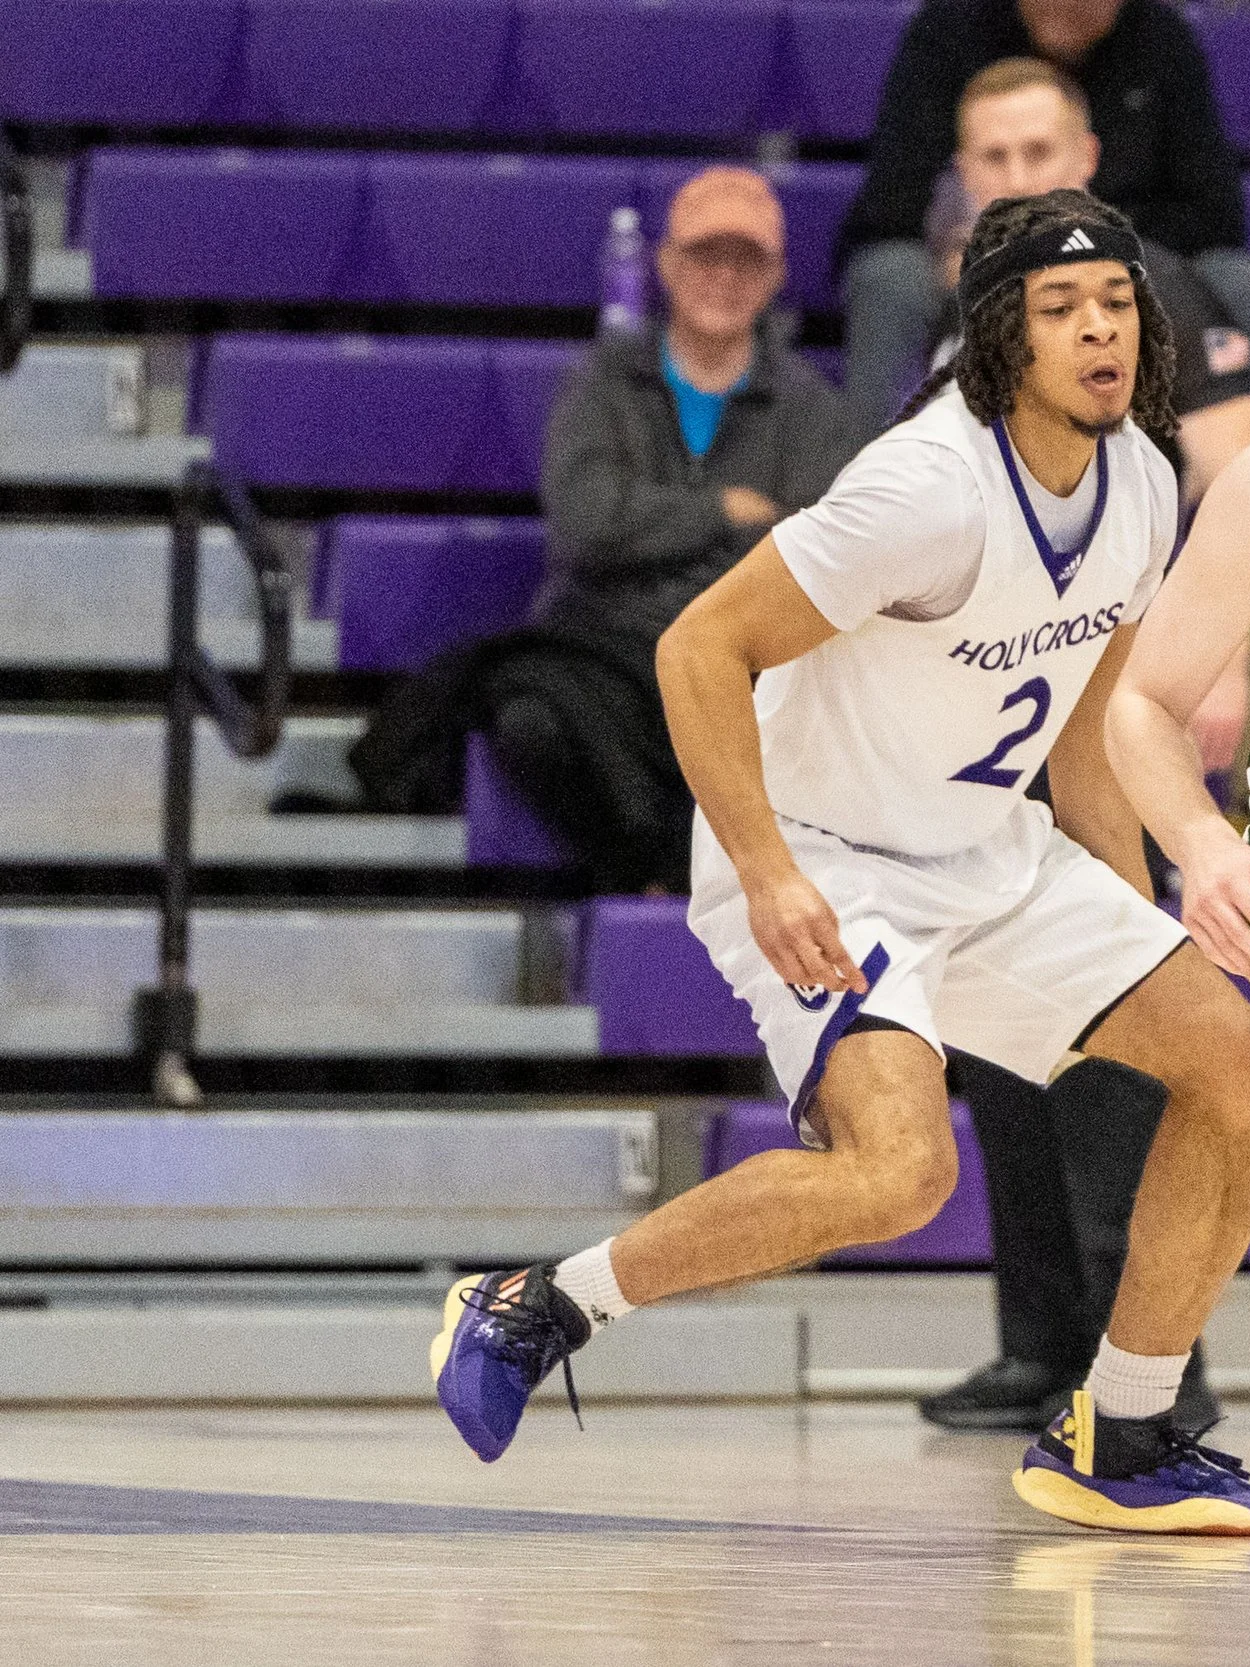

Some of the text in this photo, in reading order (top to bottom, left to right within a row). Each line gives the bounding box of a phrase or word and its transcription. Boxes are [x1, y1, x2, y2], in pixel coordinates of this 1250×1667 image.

[948, 602, 1125, 671] HOLY CROSS
[947, 675, 1052, 789] 2
